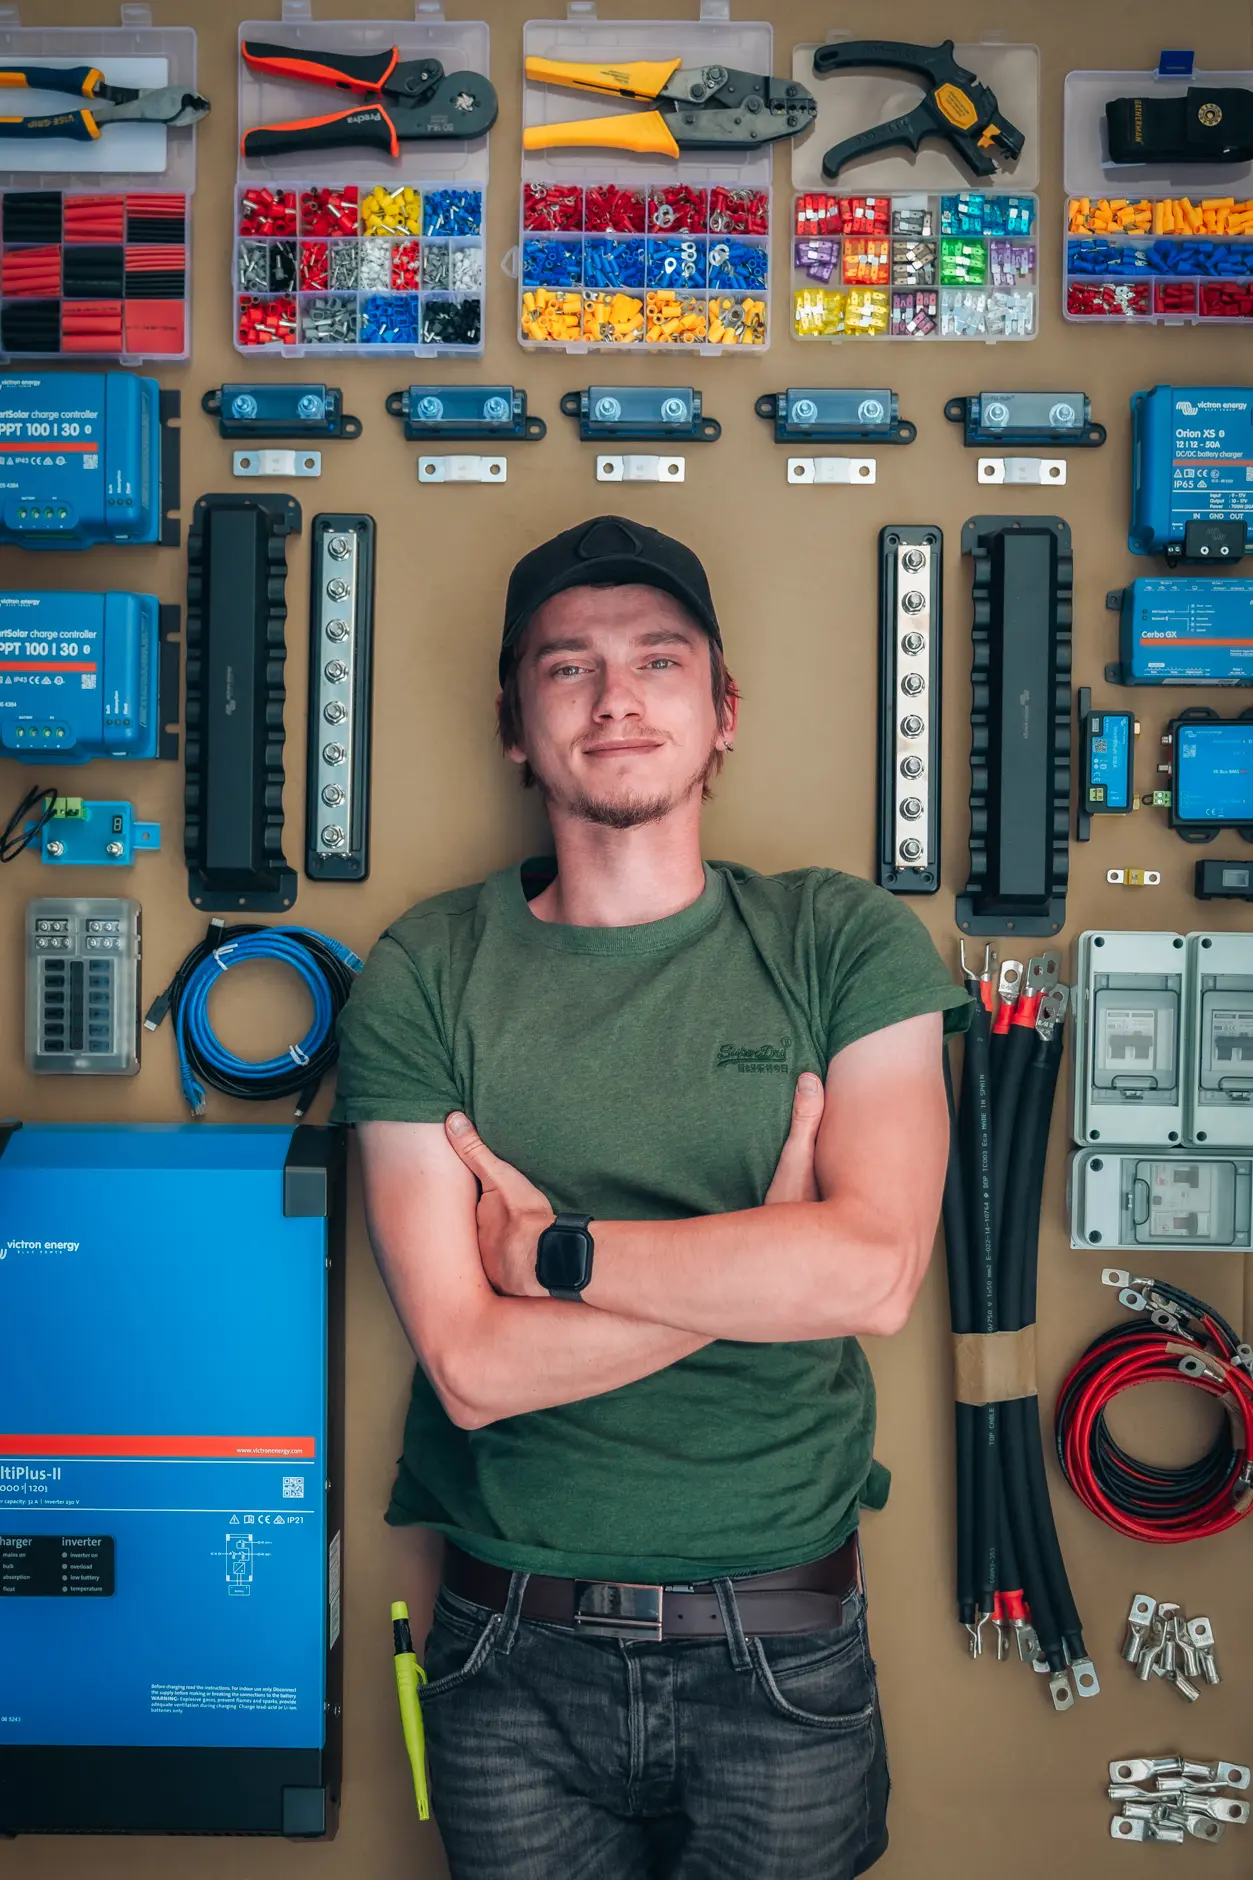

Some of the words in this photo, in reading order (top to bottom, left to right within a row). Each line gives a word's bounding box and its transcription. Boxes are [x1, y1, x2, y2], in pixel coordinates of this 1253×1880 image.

[347, 112, 381, 124] Preciva
[31, 410, 59, 420] charge
[61, 410, 98, 418] controller
[26, 423, 50, 436] 100
[61, 423, 80, 436] 30
[1176, 429, 1201, 438] Orion
[1203, 429, 1216, 438] XS
[30, 629, 58, 640] charge
[60, 630, 97, 639] controller
[25, 642, 48, 656] 100
[60, 643, 78, 656] 30
[980, 1099, 986, 1108] IN
[7, 1239, 41, 1249] victron
[44, 1242, 80, 1251] energy
[1, 1466, 61, 1480] ltiPlus-II
[62, 1537, 101, 1546] inverter
